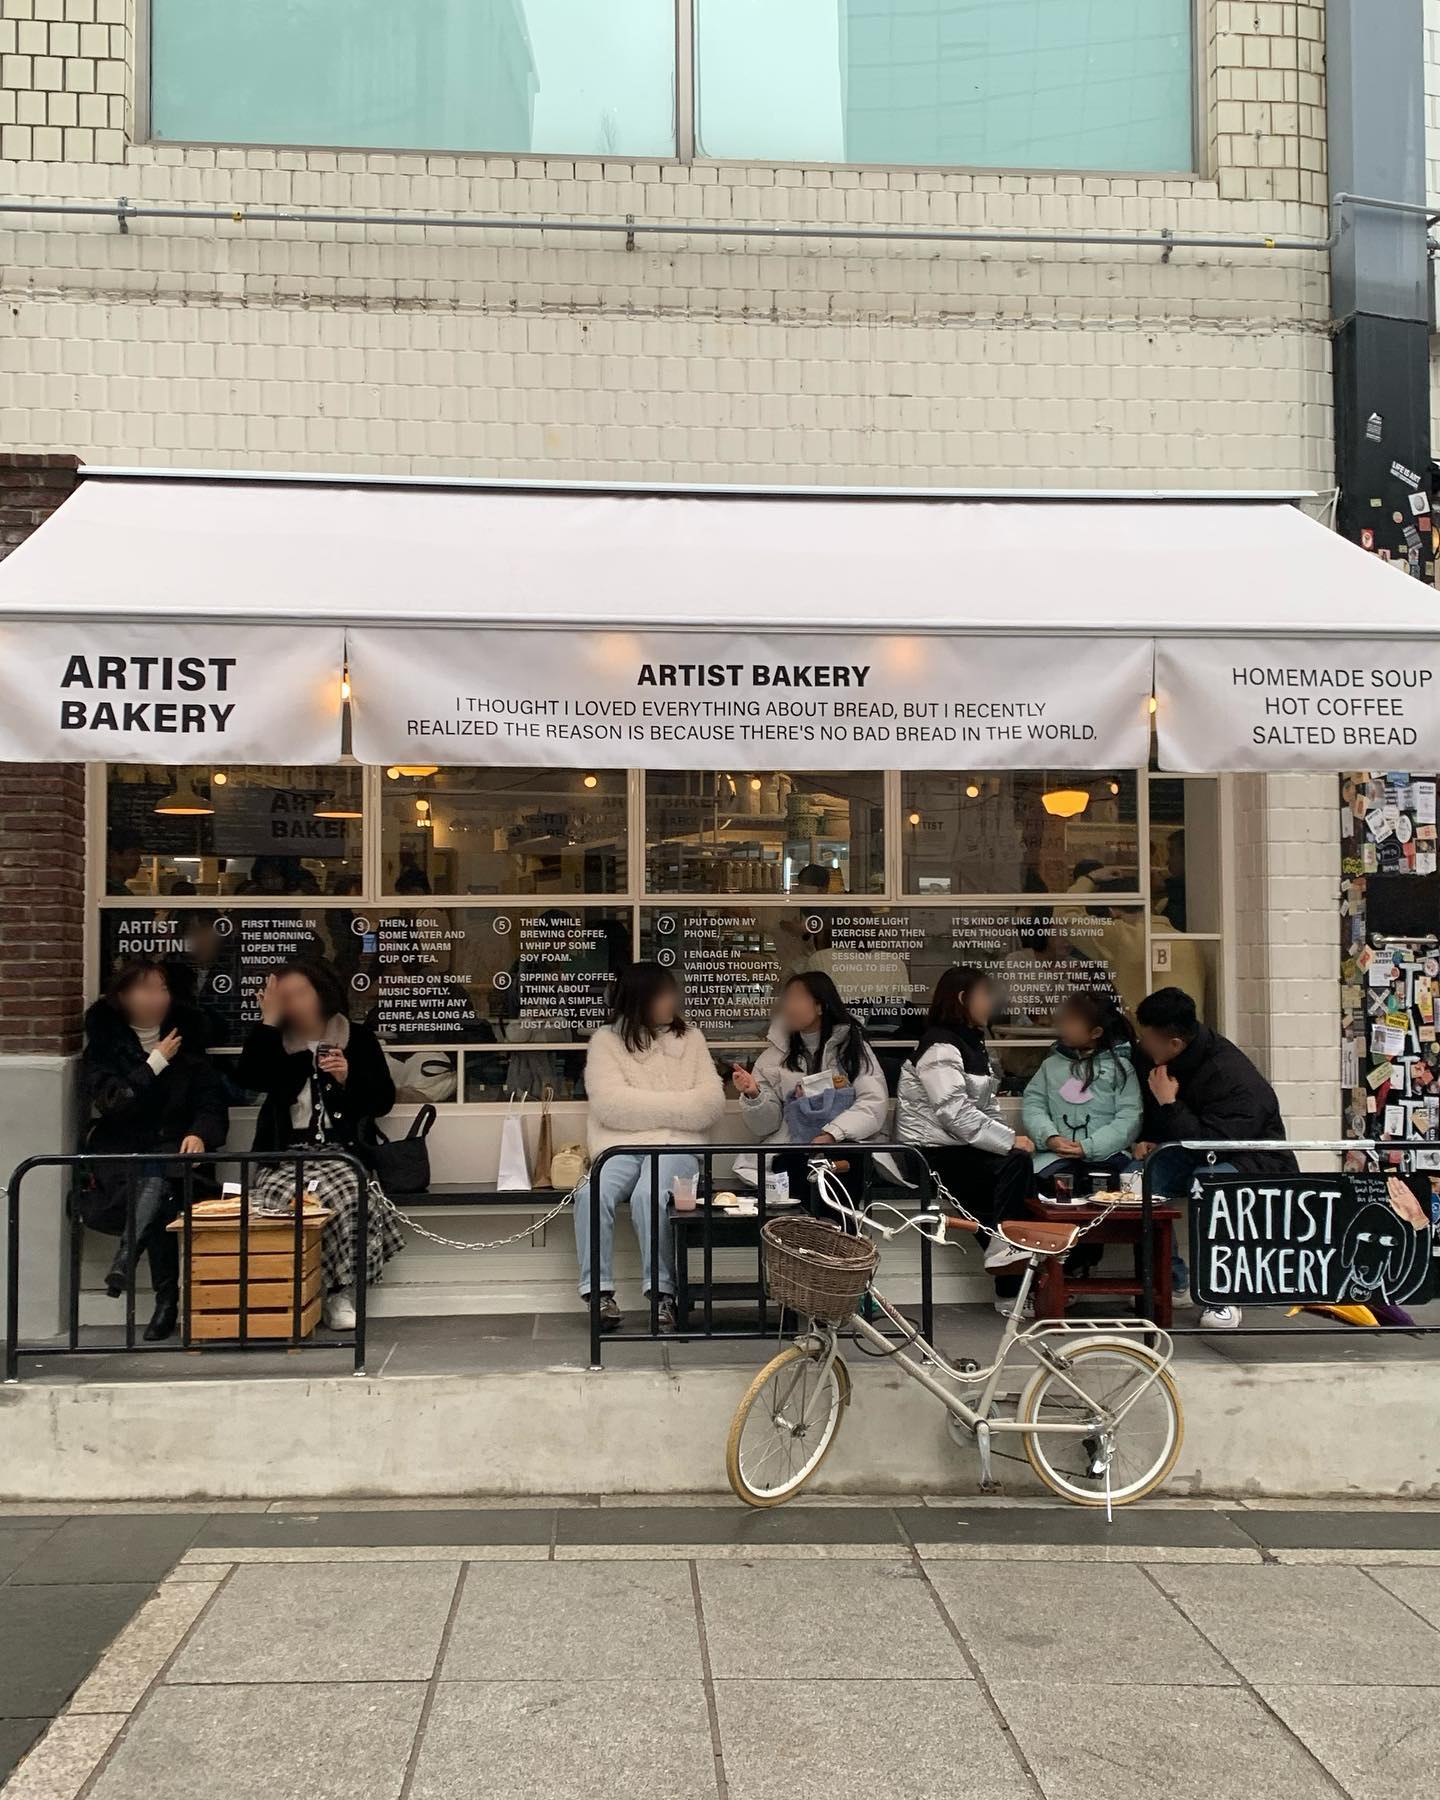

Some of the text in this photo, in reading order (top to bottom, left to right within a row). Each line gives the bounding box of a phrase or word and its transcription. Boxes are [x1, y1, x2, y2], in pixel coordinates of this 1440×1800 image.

[60, 655, 237, 691] ARTIST
[637, 664, 871, 688] ARTIST BAKERY
[1233, 667, 1433, 688] HOMEMADE SOUP
[457, 697, 1046, 720] I THOUGHT I LOVED EVERYTHING ABOUT BREAD, BUT I RECENTLY
[1266, 697, 1404, 717] HOT COFFEE
[60, 701, 235, 734] BAKERY
[407, 720, 1097, 742] REALIZED THE REASON IS BECAUSE THERE'S NO BAD BREAD IN THE WORLD.
[1253, 726, 1417, 746] SALTED BREAD
[242, 920, 269, 928] FIRST
[273, 920, 303, 928] THING
[379, 920, 407, 929] THEN,
[416, 919, 438, 927] BOIL
[520, 918, 581, 927] THEN, WHILE
[685, 918, 756, 926] I PUT DOWN MY
[882, 917, 909, 925] LIGHT
[972, 917, 994, 925] KIND
[997, 917, 1009, 925] OF
[1012, 917, 1031, 925] LIKE
[1034, 917, 1040, 925] A
[1043, 917, 1068, 925] DAILY
[118, 921, 178, 934] ARTIST
[242, 932, 315, 941] THE MORNING,
[379, 931, 465, 939] SOME WATER AND
[520, 930, 607, 939] BREWING COFFEE,
[832, 929, 876, 937] EXERCISE
[878, 929, 898, 937] AND
[978, 929, 1018, 937] THOUGH
[1021, 928, 1035, 936] NO
[1037, 928, 1056, 936] ONE
[1059, 928, 1068, 936] IS
[1070, 928, 1104, 936] SAYING
[248, 944, 275, 952] OPEN
[278, 944, 297, 952] THE
[379, 942, 451, 951] DRINK A WARM
[520, 942, 596, 950] I WHIP UP SOME
[832, 941, 856, 949] HAVE
[953, 940, 1000, 948] ANYTHING
[379, 955, 438, 963] CUP OF TEA.
[520, 954, 572, 962] SOY FOAM.
[690, 950, 728, 959] ENGAGE
[731, 950, 740, 958] IN
[832, 952, 910, 960] SESSION BEFORE
[1157, 949, 1167, 965] B
[241, 956, 288, 964] WINDOW.
[685, 962, 782, 971] VARIOUS THOUGHTS,
[241, 976, 262, 984] AND
[379, 975, 471, 984] I TURNED ON SOME
[520, 973, 617, 983] SIPPING MY COFFEE,
[685, 973, 780, 983] WRITE NOTES, READ,
[997, 972, 1015, 980] FOR
[1018, 972, 1035, 980] THE
[1038, 972, 1066, 980] FIRST
[1069, 972, 1092, 981] TIME,
[1094, 972, 1105, 980] AS
[379, 987, 450, 996] MUSIC SOFTLY.
[525, 985, 555, 993] THINK
[557, 985, 589, 993] ABOUT
[685, 985, 774, 994] OR LISTEN ATTENT-
[379, 999, 467, 1008] I'M FINE WITH ANY
[520, 997, 557, 1005] HAVING
[559, 997, 566, 1005] A
[379, 1011, 415, 1020] GENRE,
[417, 1011, 430, 1019] AS
[433, 1011, 459, 1019] LONG
[520, 1009, 578, 1018] BREAKFAST,
[580, 1008, 605, 1016] EVEN
[379, 1023, 463, 1031] IT'S REFRESHING.
[520, 1020, 604, 1029] JUST A QUICK BIT
[1208, 1188, 1341, 1244] ARTIST
[1210, 1245, 1336, 1295] BAKERY
